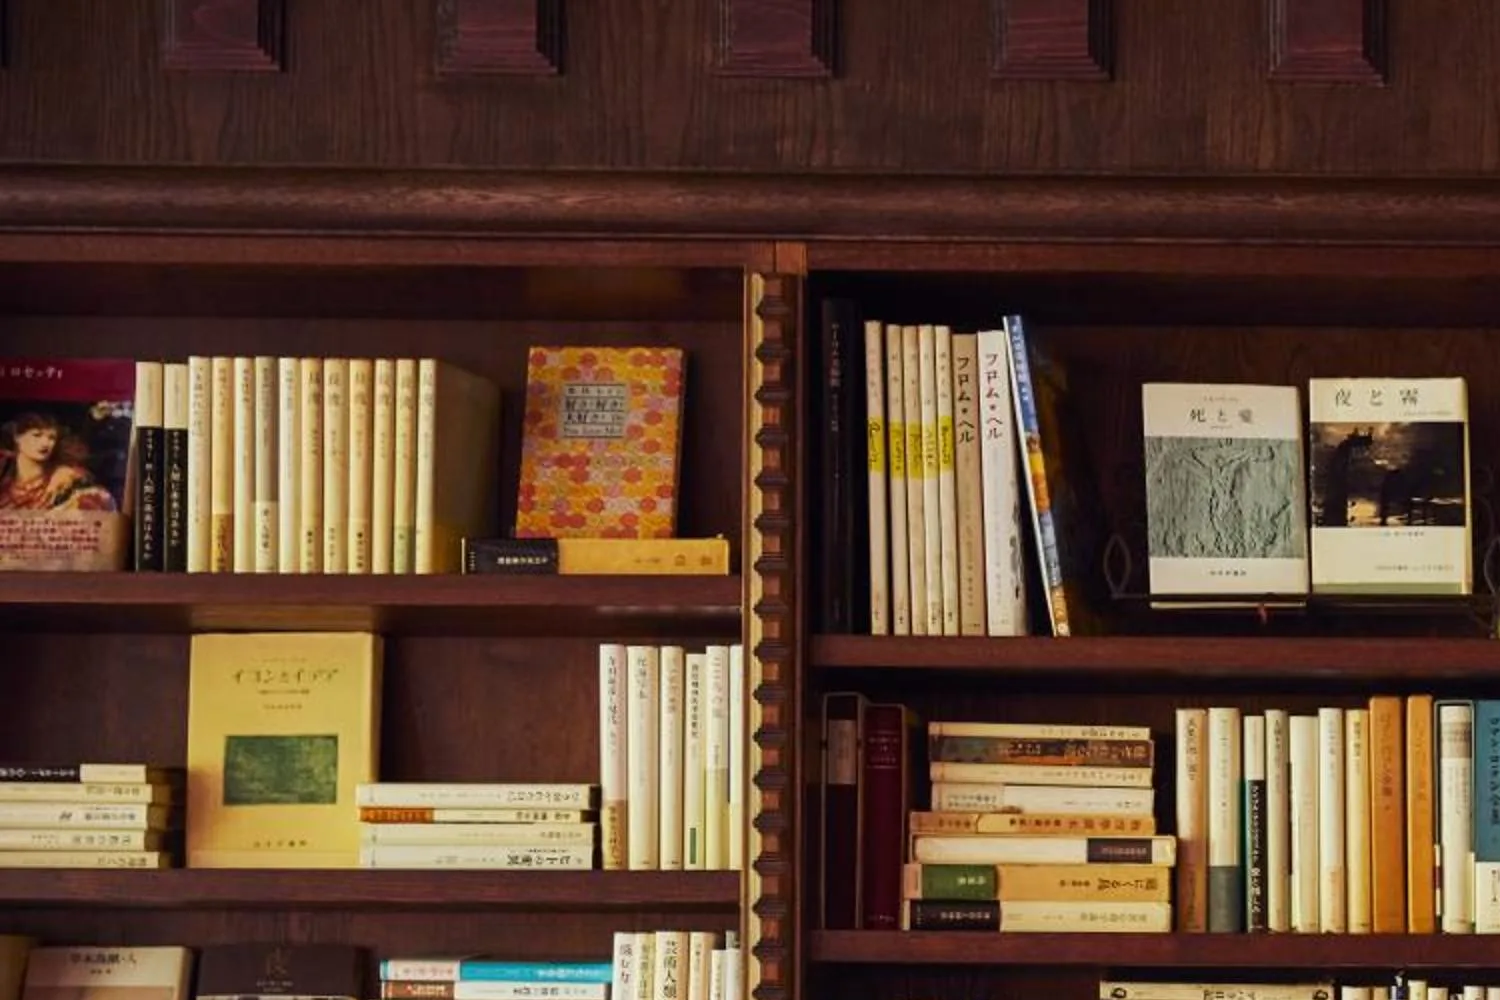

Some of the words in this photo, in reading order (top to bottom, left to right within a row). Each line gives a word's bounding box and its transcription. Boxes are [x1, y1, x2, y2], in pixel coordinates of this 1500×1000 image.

[957, 356, 975, 444] フロム・ヘル
[985, 352, 1003, 440] フロム・ヘル
